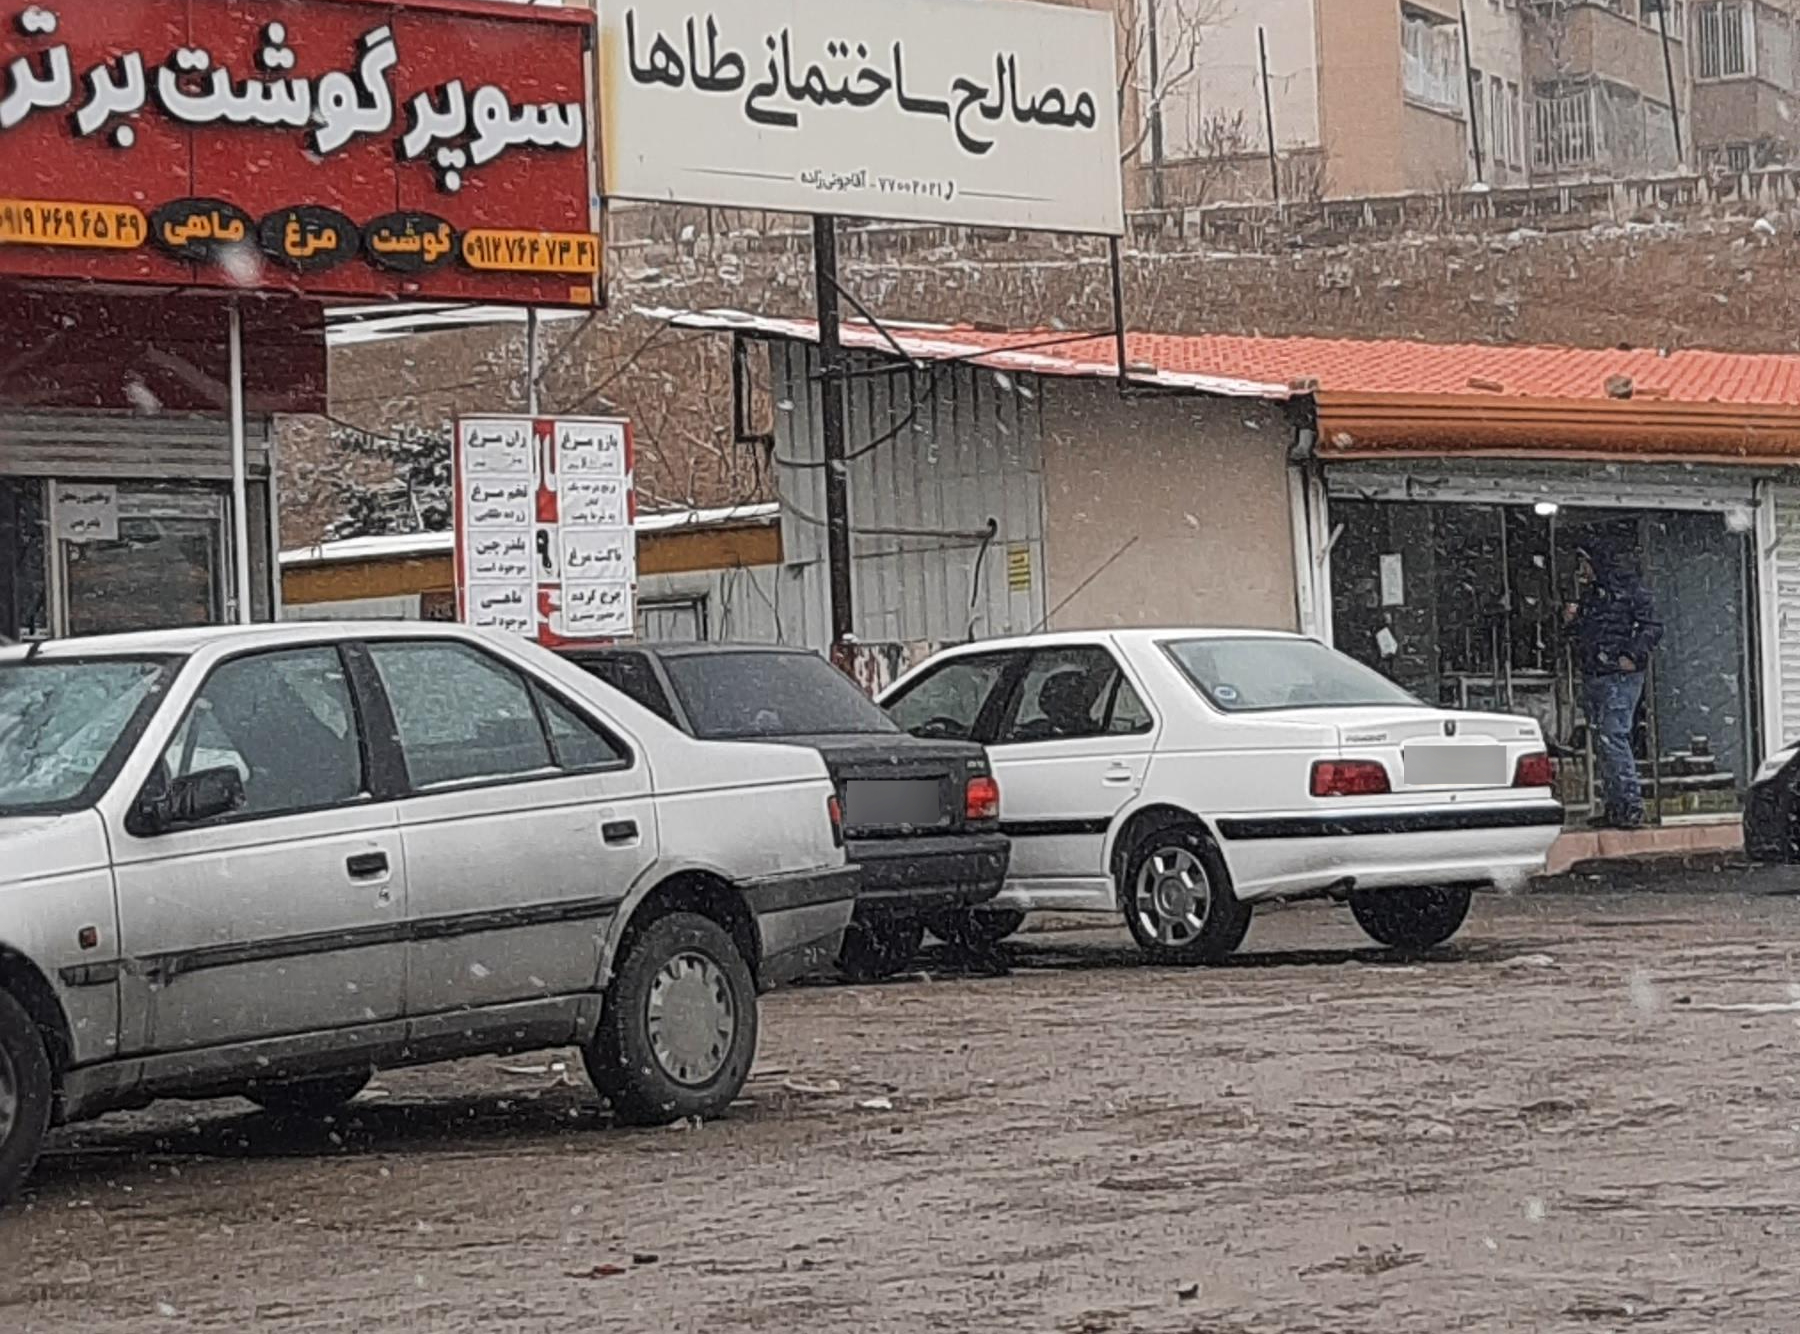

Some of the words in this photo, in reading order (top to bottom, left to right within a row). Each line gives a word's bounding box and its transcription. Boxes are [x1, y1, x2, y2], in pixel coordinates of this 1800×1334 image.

[625, 8, 746, 92] طاها
[0, 5, 147, 147] برتر
[744, 27, 952, 128] ساختمانی
[157, 21, 398, 154] گوشت
[952, 50, 1096, 154] مصالح
[403, 80, 583, 191] سوپر
[0, 206, 35, 235] ۹۱۹
[163, 211, 245, 245] ماهی
[284, 213, 338, 257] مرغ
[371, 219, 451, 262] گوشت
[468, 428, 503, 448] مرغ
[506, 429, 527, 448] ران
[561, 431, 593, 451] مرغ
[471, 483, 504, 502] مرغ
[506, 484, 528, 502] تخم
[568, 547, 592, 567] مرغ
[476, 562, 497, 573] است
[498, 562, 526, 575] موجود
[480, 589, 522, 609] ماهی
[476, 615, 497, 627] است
[498, 617, 528, 631] موجود
